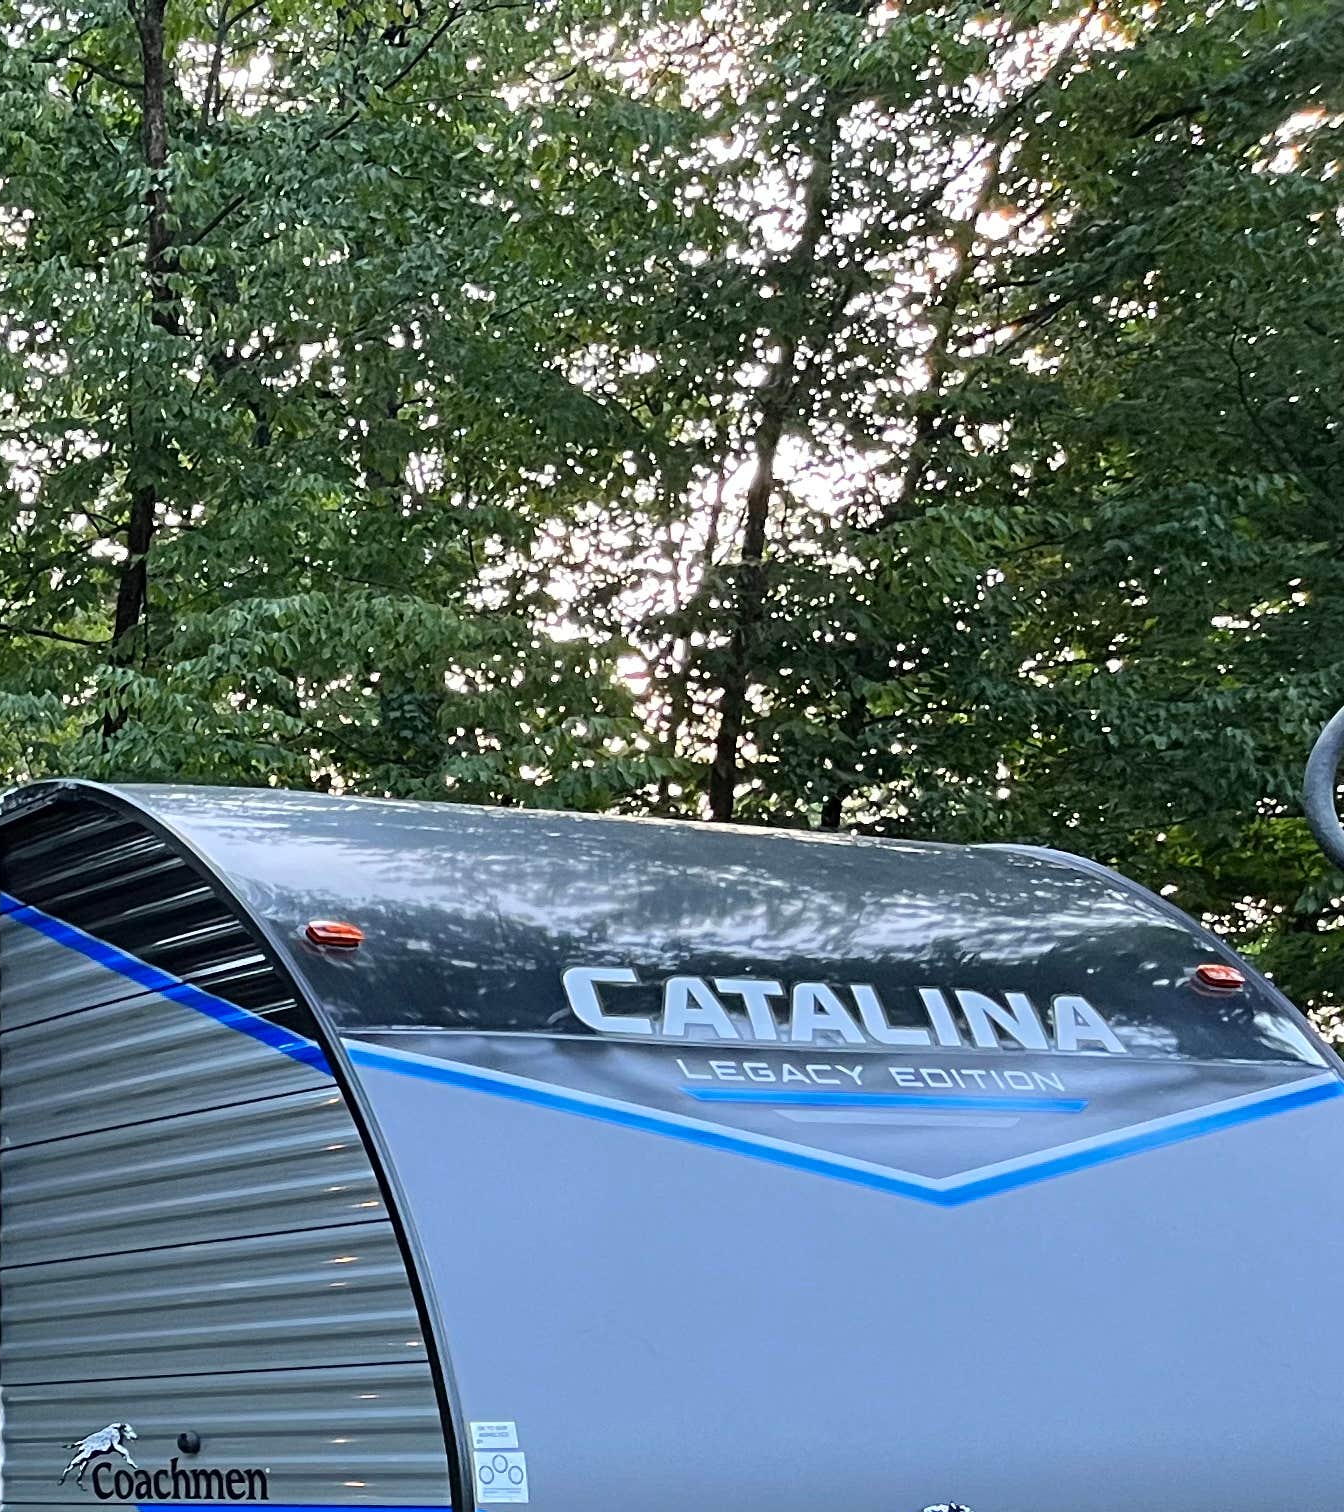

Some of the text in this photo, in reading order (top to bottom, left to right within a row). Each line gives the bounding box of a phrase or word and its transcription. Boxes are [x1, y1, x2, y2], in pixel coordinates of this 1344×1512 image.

[563, 967, 1126, 1053] CATALINA
[676, 1059, 1066, 1092] LEGACY EDITION
[92, 1457, 270, 1500] Coachmen
